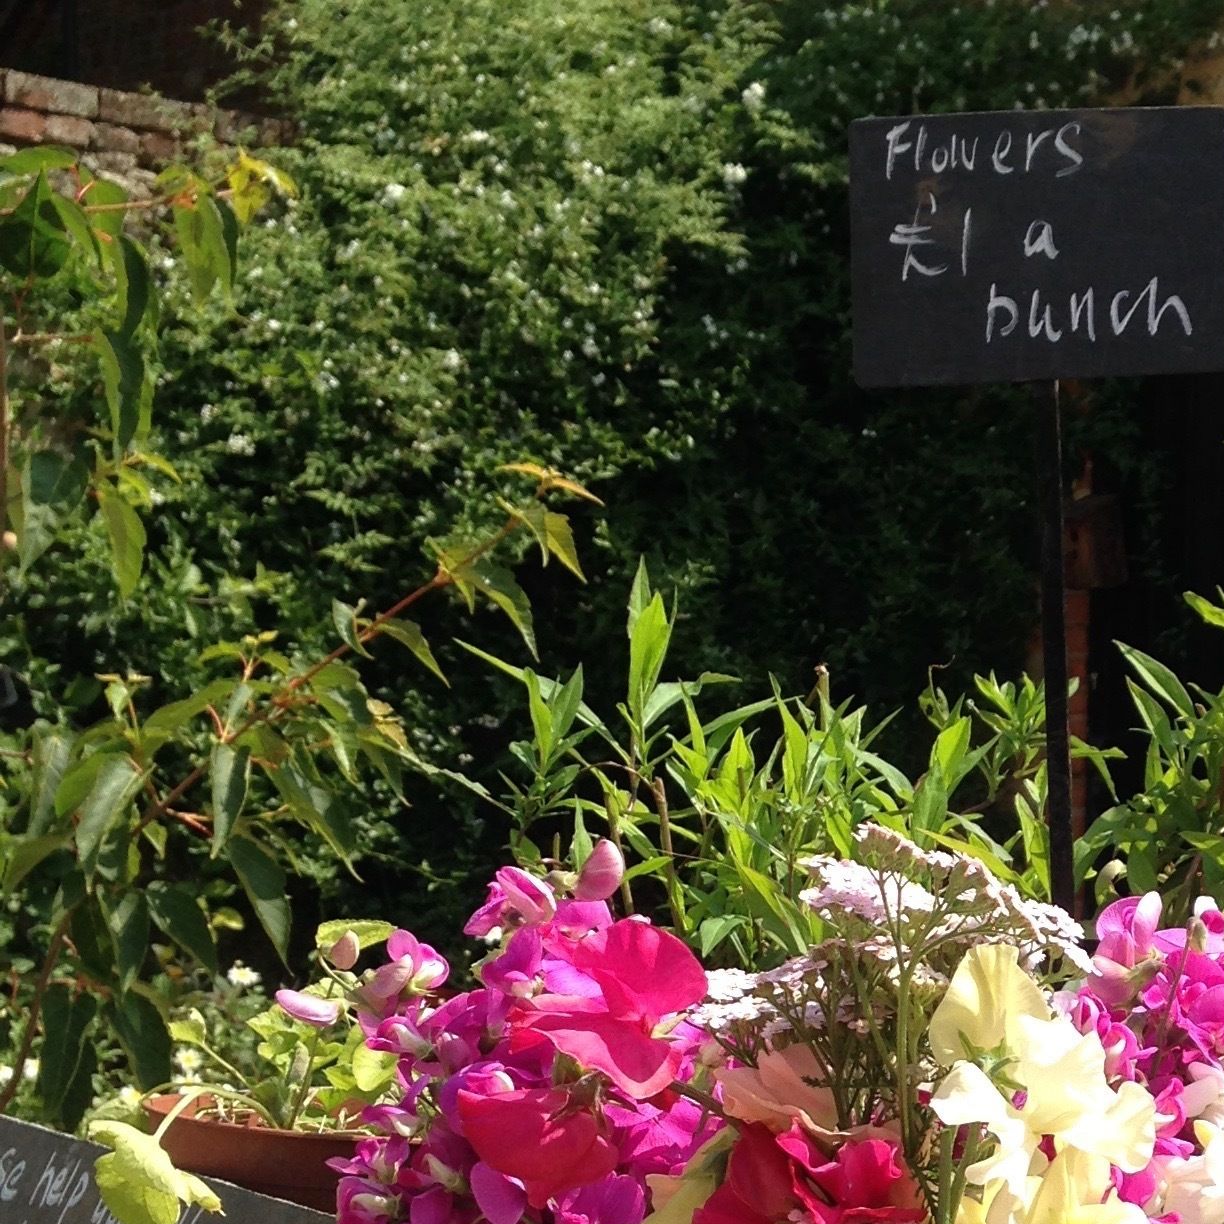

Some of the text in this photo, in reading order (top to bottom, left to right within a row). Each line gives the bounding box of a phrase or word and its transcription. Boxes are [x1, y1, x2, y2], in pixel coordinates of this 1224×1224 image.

[886, 121, 1084, 180] Flowers
[889, 193, 1060, 281] £1 a
[985, 276, 1193, 344] bunch
